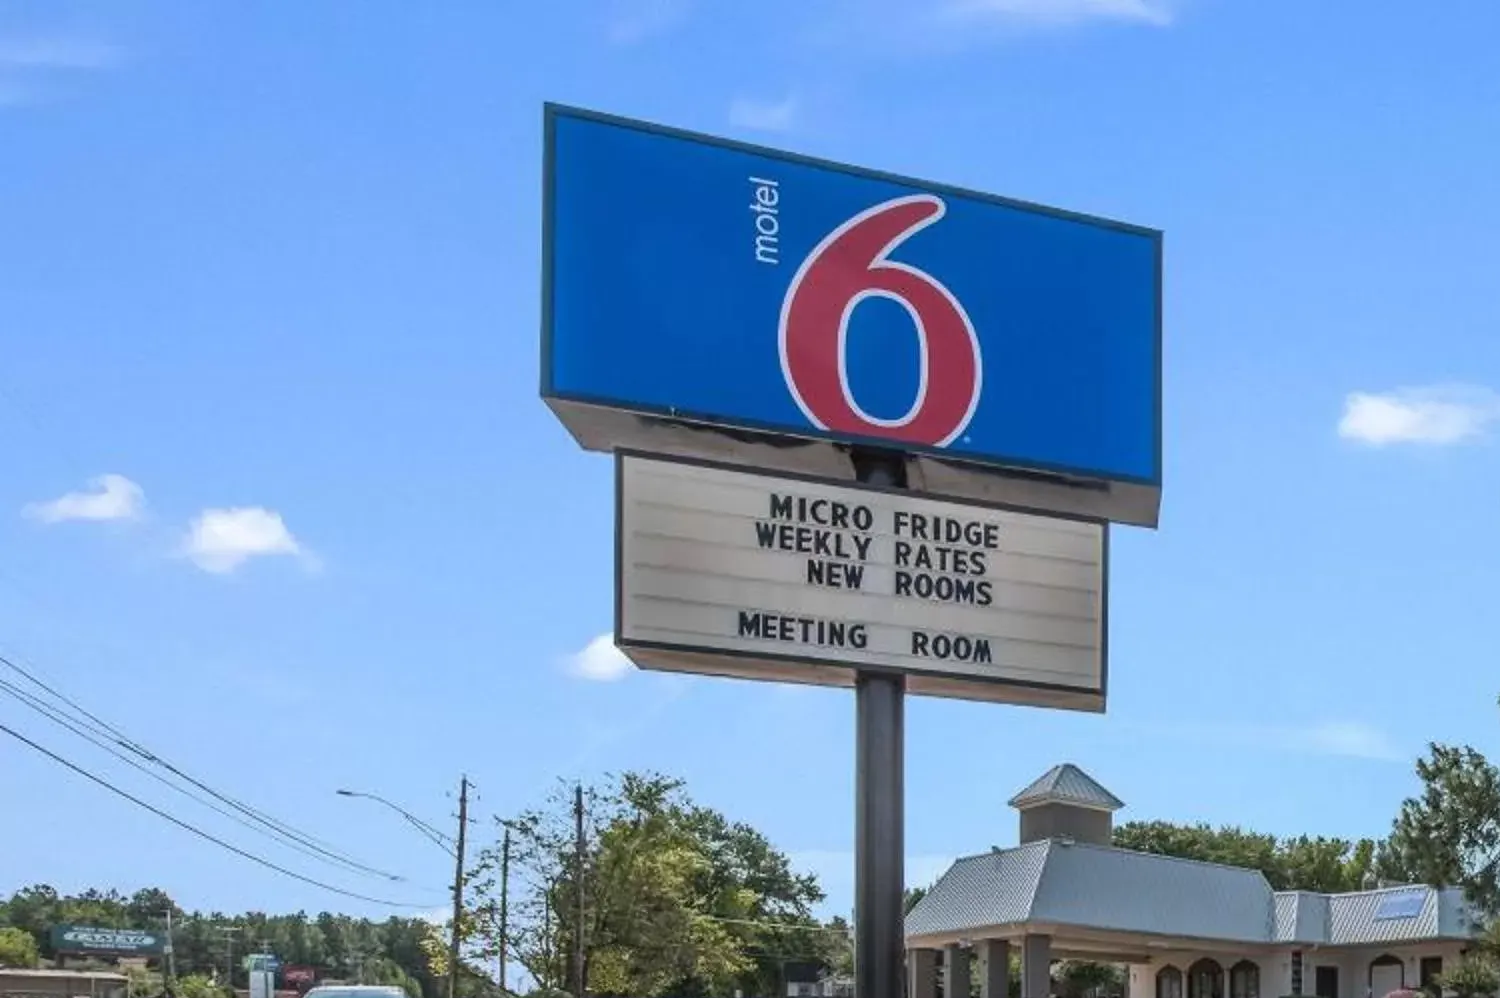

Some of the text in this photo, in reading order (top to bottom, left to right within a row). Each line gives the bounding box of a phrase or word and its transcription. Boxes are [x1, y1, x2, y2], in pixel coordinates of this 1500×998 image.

[749, 177, 778, 264] motel
[778, 194, 982, 448] 6
[756, 521, 986, 576] WEEKLY RATES
[770, 493, 999, 549] MICRO FRIDGE
[807, 559, 993, 605] NEW ROOMS
[738, 611, 992, 664] MEETING ROOM
